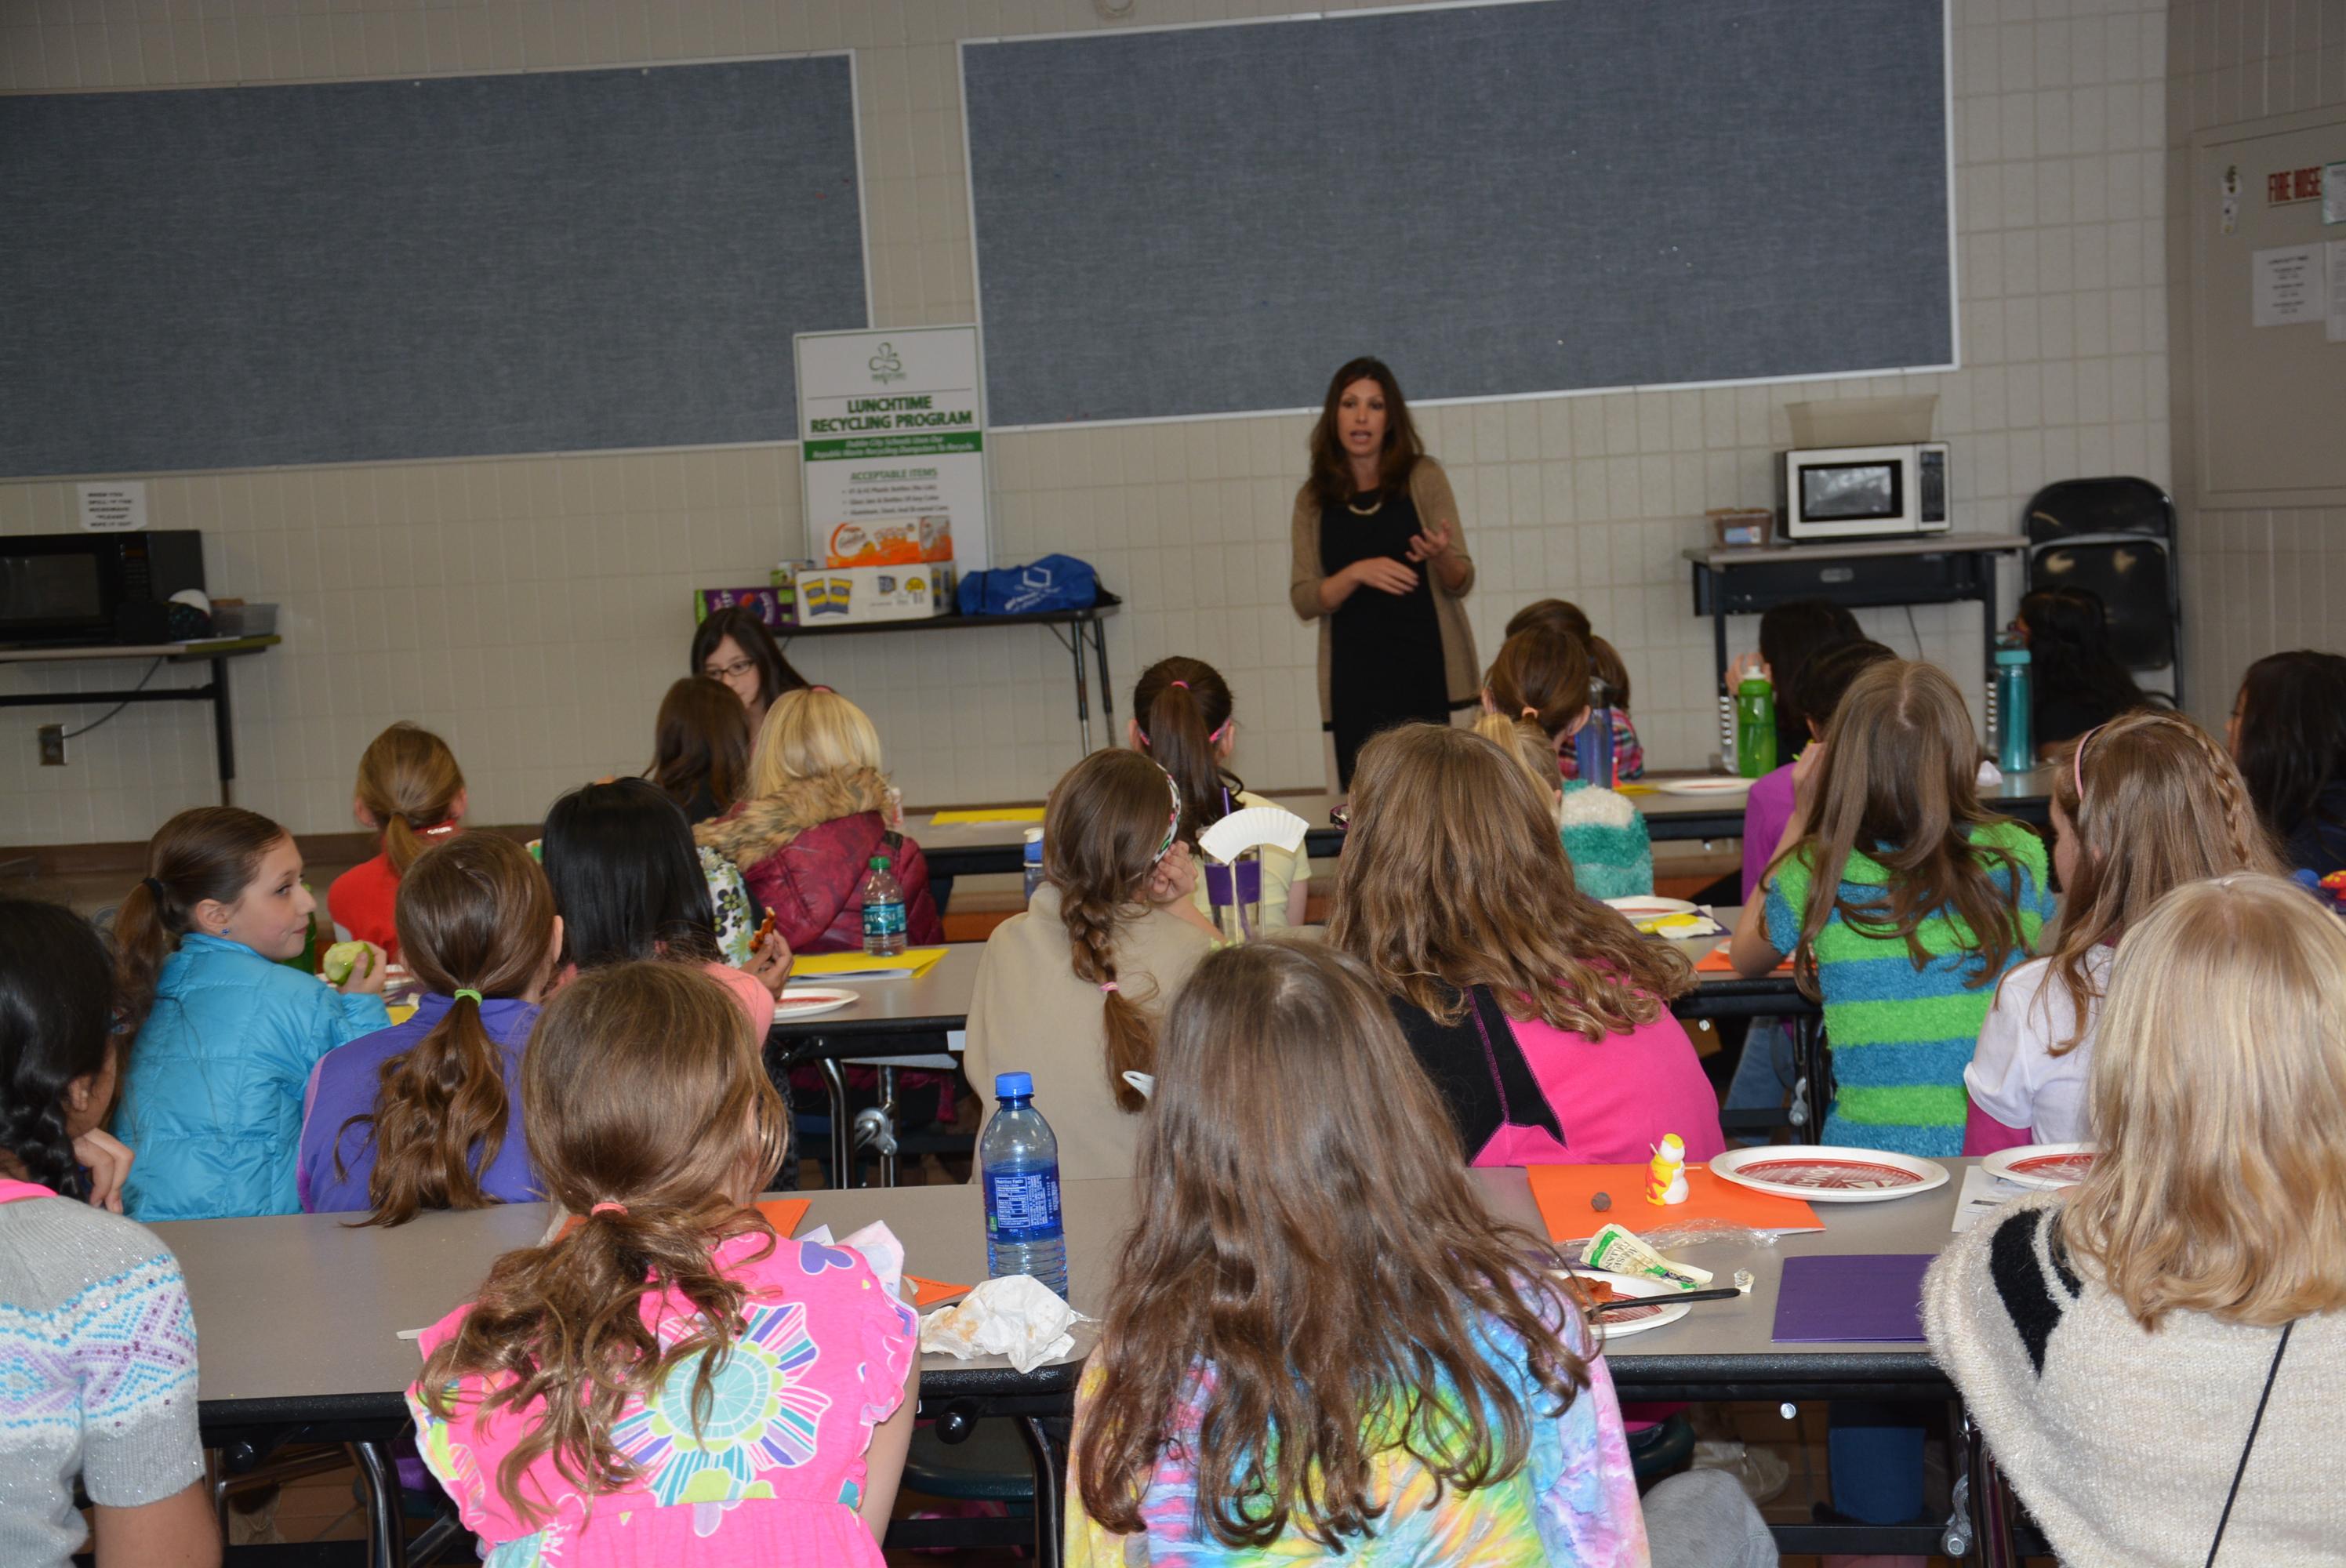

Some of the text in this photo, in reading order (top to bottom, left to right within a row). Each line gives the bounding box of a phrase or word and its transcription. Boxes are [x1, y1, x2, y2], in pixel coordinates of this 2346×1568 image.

[848, 395, 932, 414] LUNCHTIME
[810, 410, 972, 433] RECYCLING PROGRAM
[851, 467, 938, 481] ACCEPTABLE ITEMS
